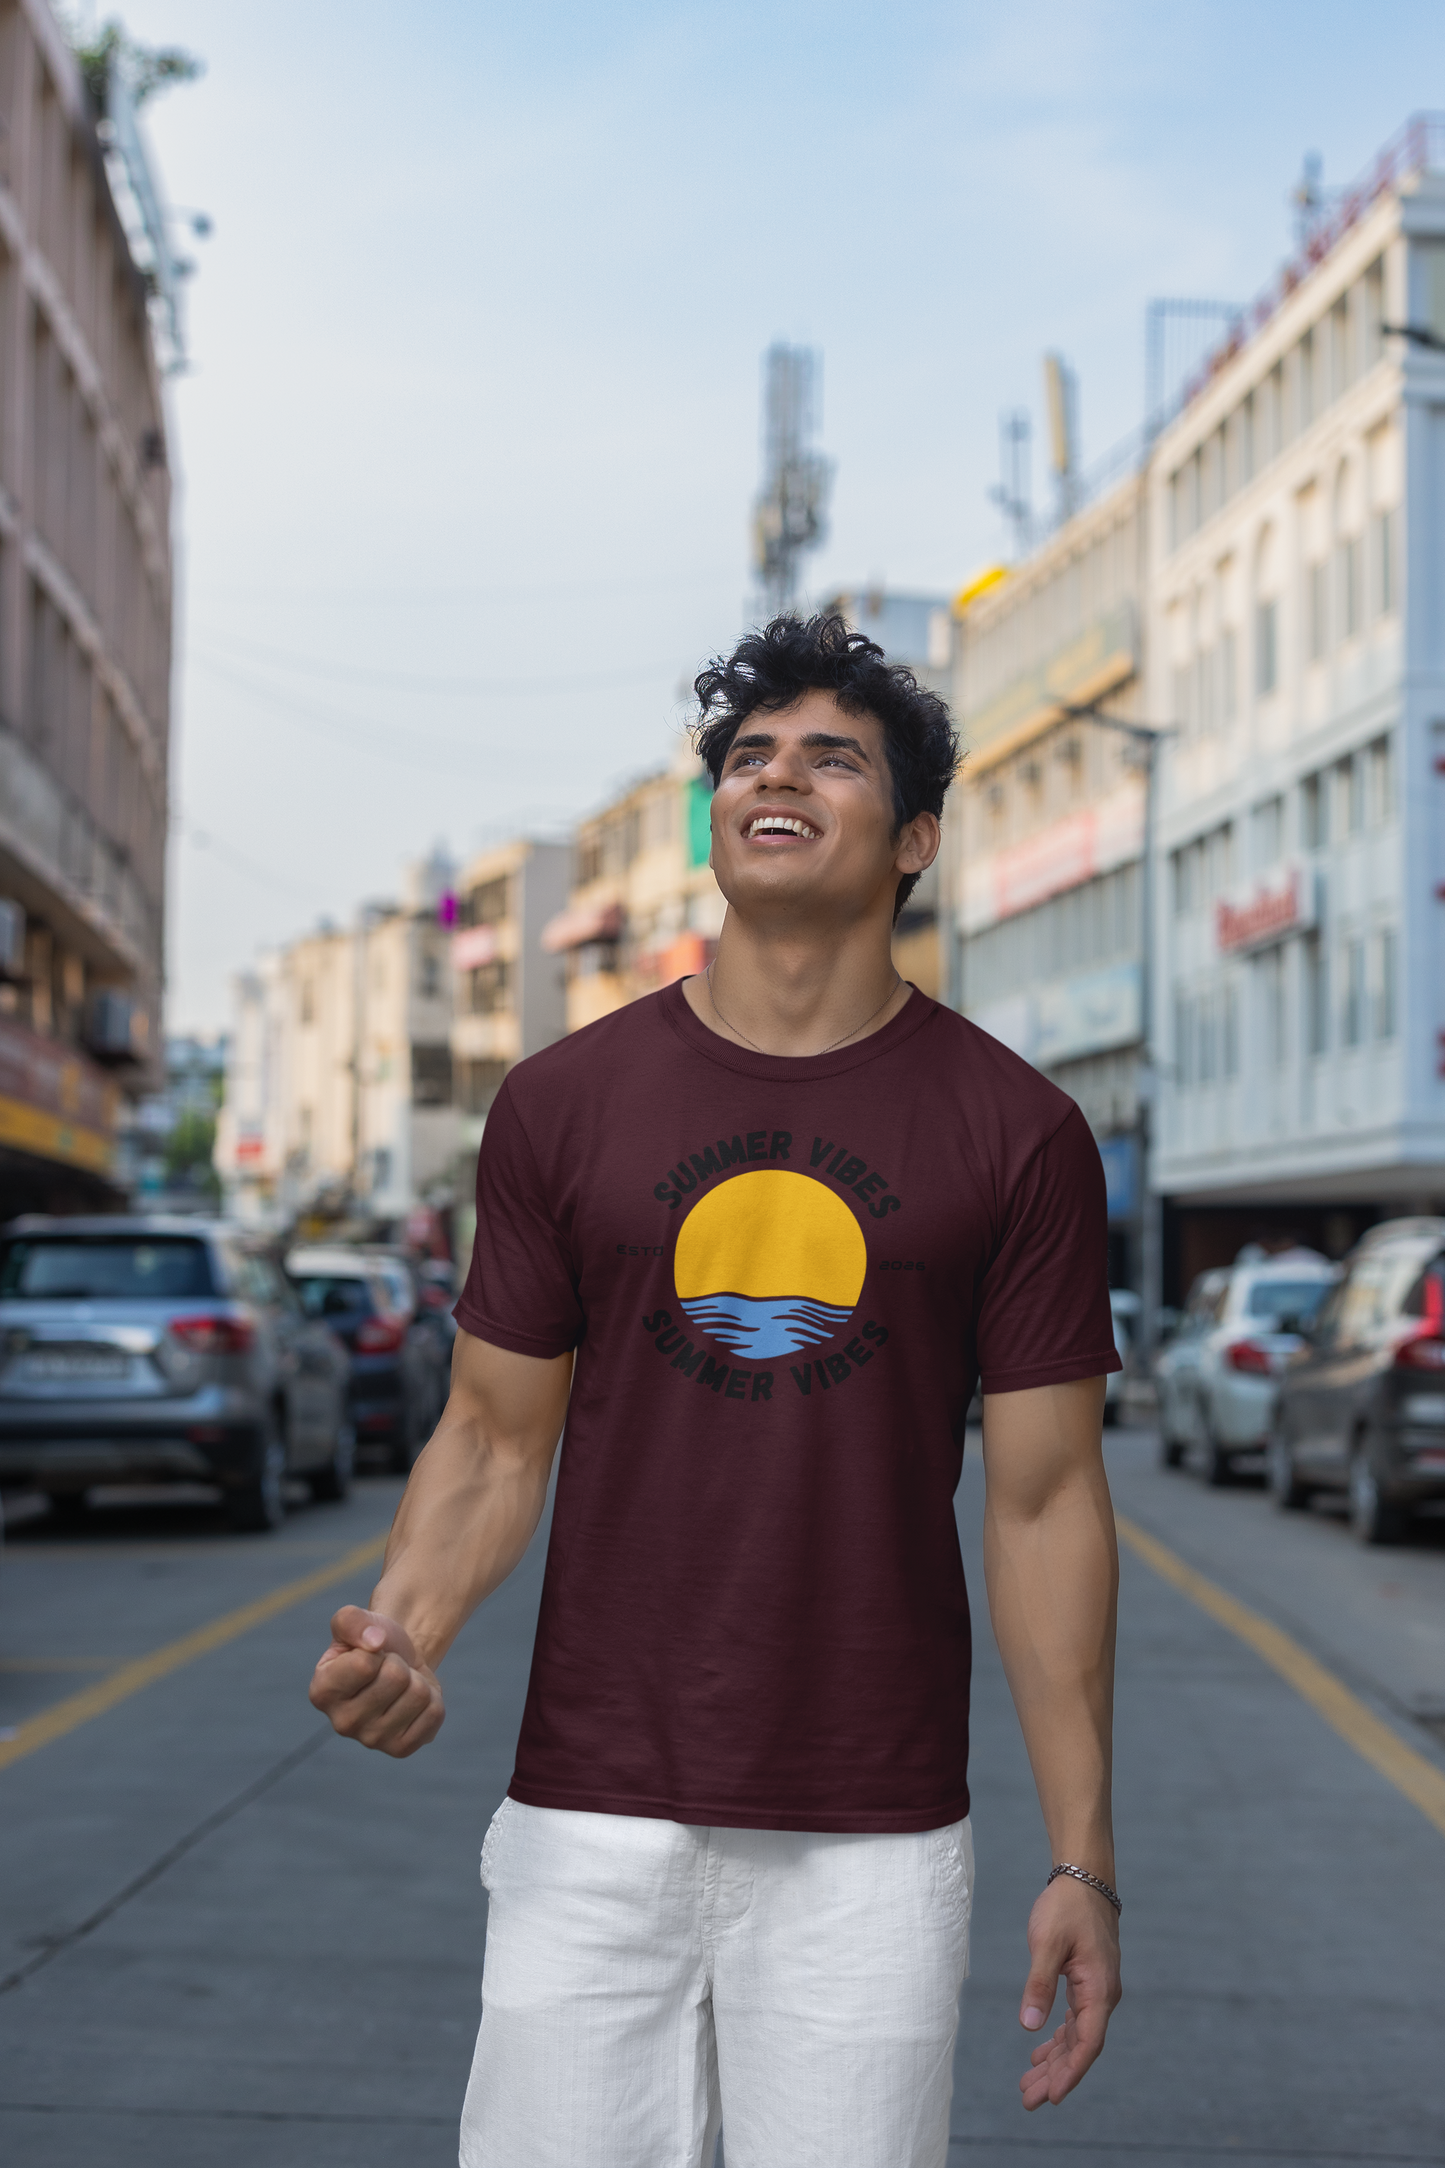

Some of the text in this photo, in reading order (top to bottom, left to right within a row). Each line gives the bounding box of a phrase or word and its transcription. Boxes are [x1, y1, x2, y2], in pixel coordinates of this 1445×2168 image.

[653, 1130, 902, 1220] SUMMER VIBES
[878, 1260, 926, 1271] 2026
[641, 1309, 890, 1402] SUMMER VIBES
